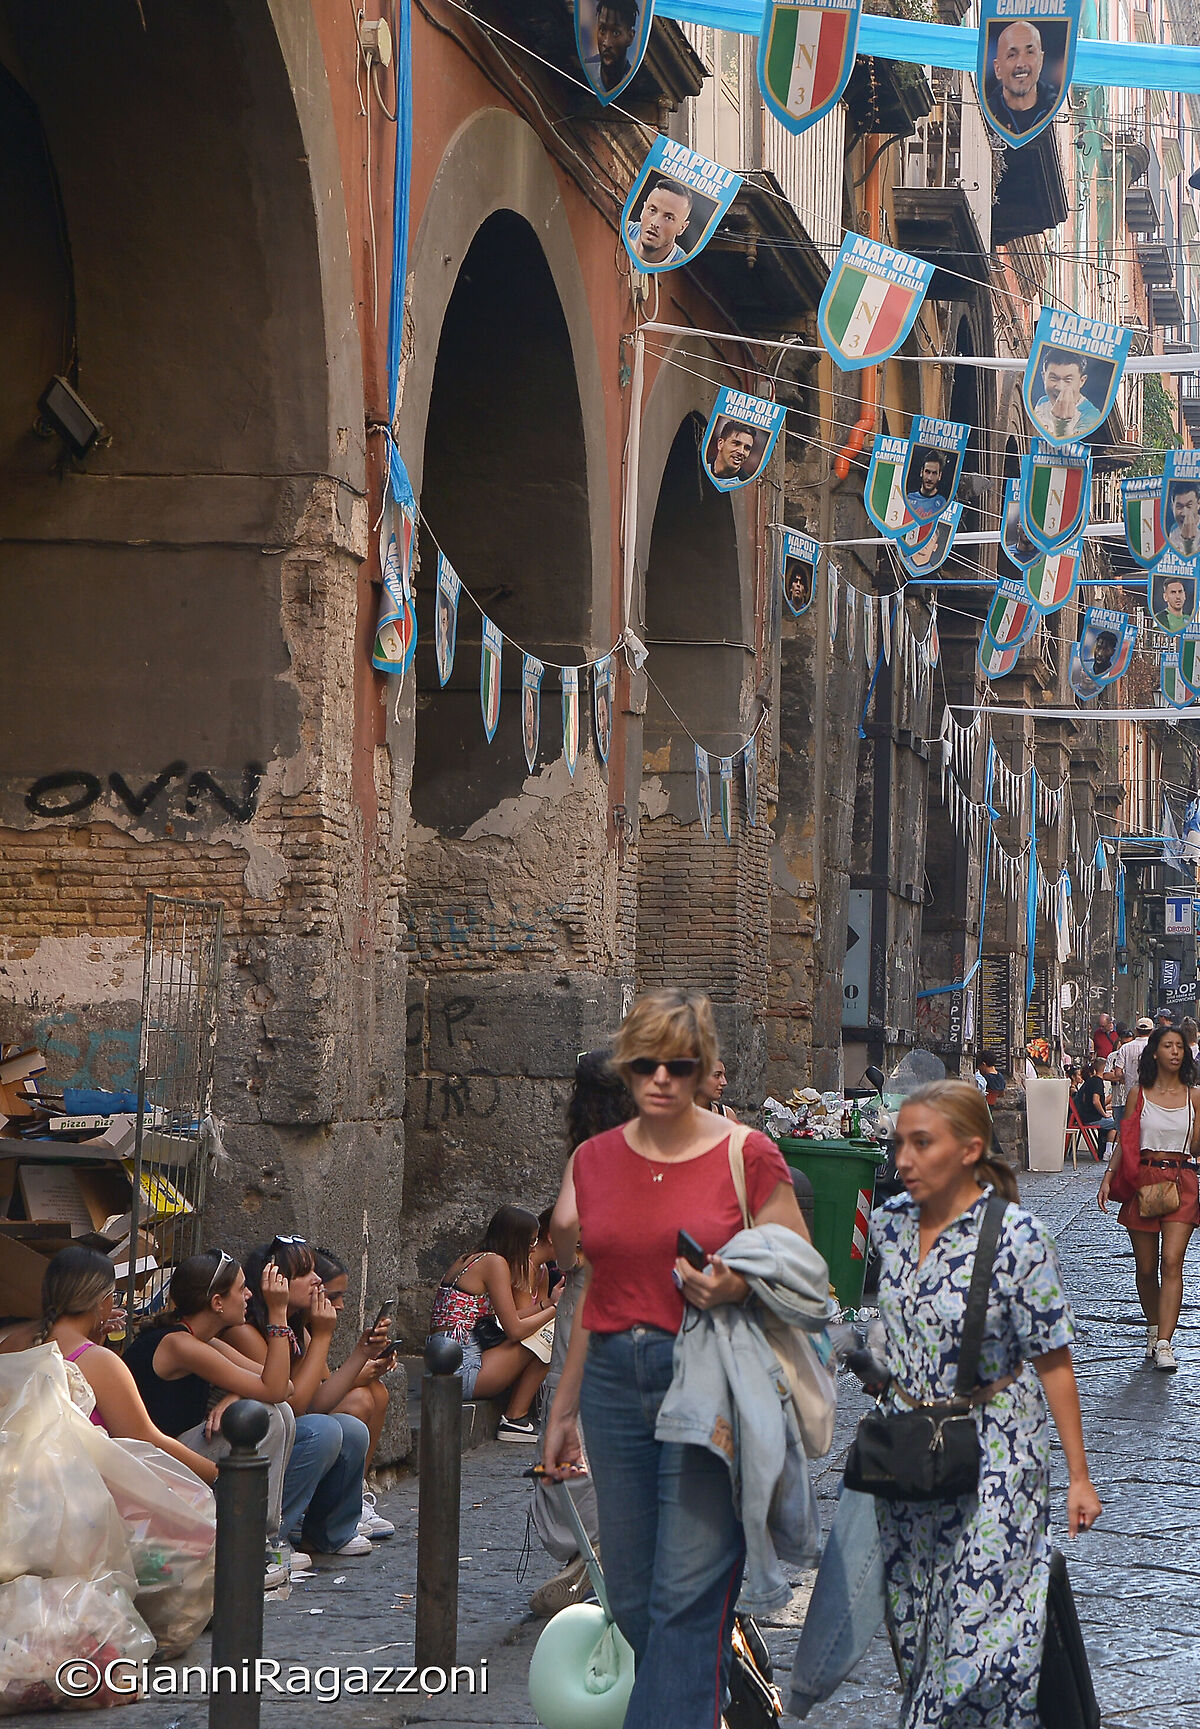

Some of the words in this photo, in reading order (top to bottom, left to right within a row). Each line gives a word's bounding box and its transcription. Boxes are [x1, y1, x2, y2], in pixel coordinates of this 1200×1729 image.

[996, 0, 1067, 15] CAMPIONE
[796, 43, 816, 70] N
[795, 87, 806, 106] 3
[661, 140, 735, 189] NAPOLI
[660, 157, 723, 198] CAMPIONE
[851, 236, 927, 280] NAPOLI
[842, 251, 888, 278] CAMPIONE
[886, 268, 899, 283] IN
[897, 272, 925, 292] ITALIA
[855, 300, 879, 325] N
[1049, 311, 1124, 346] NAPOLI
[848, 334, 861, 349] 3
[1050, 328, 1116, 358] CAMPIONE
[725, 390, 781, 420] NAPOLI
[725, 404, 773, 428] CAMPIONE
[919, 417, 964, 440] NAPOLI
[919, 431, 958, 451] CAMPIONE
[1049, 490, 1063, 506] N
[890, 510, 899, 522] 3
[1049, 517, 1055, 529] 3
[1142, 517, 1153, 534] N
[788, 533, 816, 553] NAPOLI
[909, 530, 915, 540] 3
[788, 545, 814, 562] CAMPIONE
[1145, 542, 1151, 553] 3
[1157, 564, 1194, 577] CAMPIONE
[1044, 591, 1050, 601] 3
[1090, 608, 1125, 624] NAPOLI
[1091, 618, 1121, 632] CAMPIONE
[386, 637, 398, 653] 3
[61, 1120, 87, 1130] pizza
[94, 1118, 114, 1128] pizz
